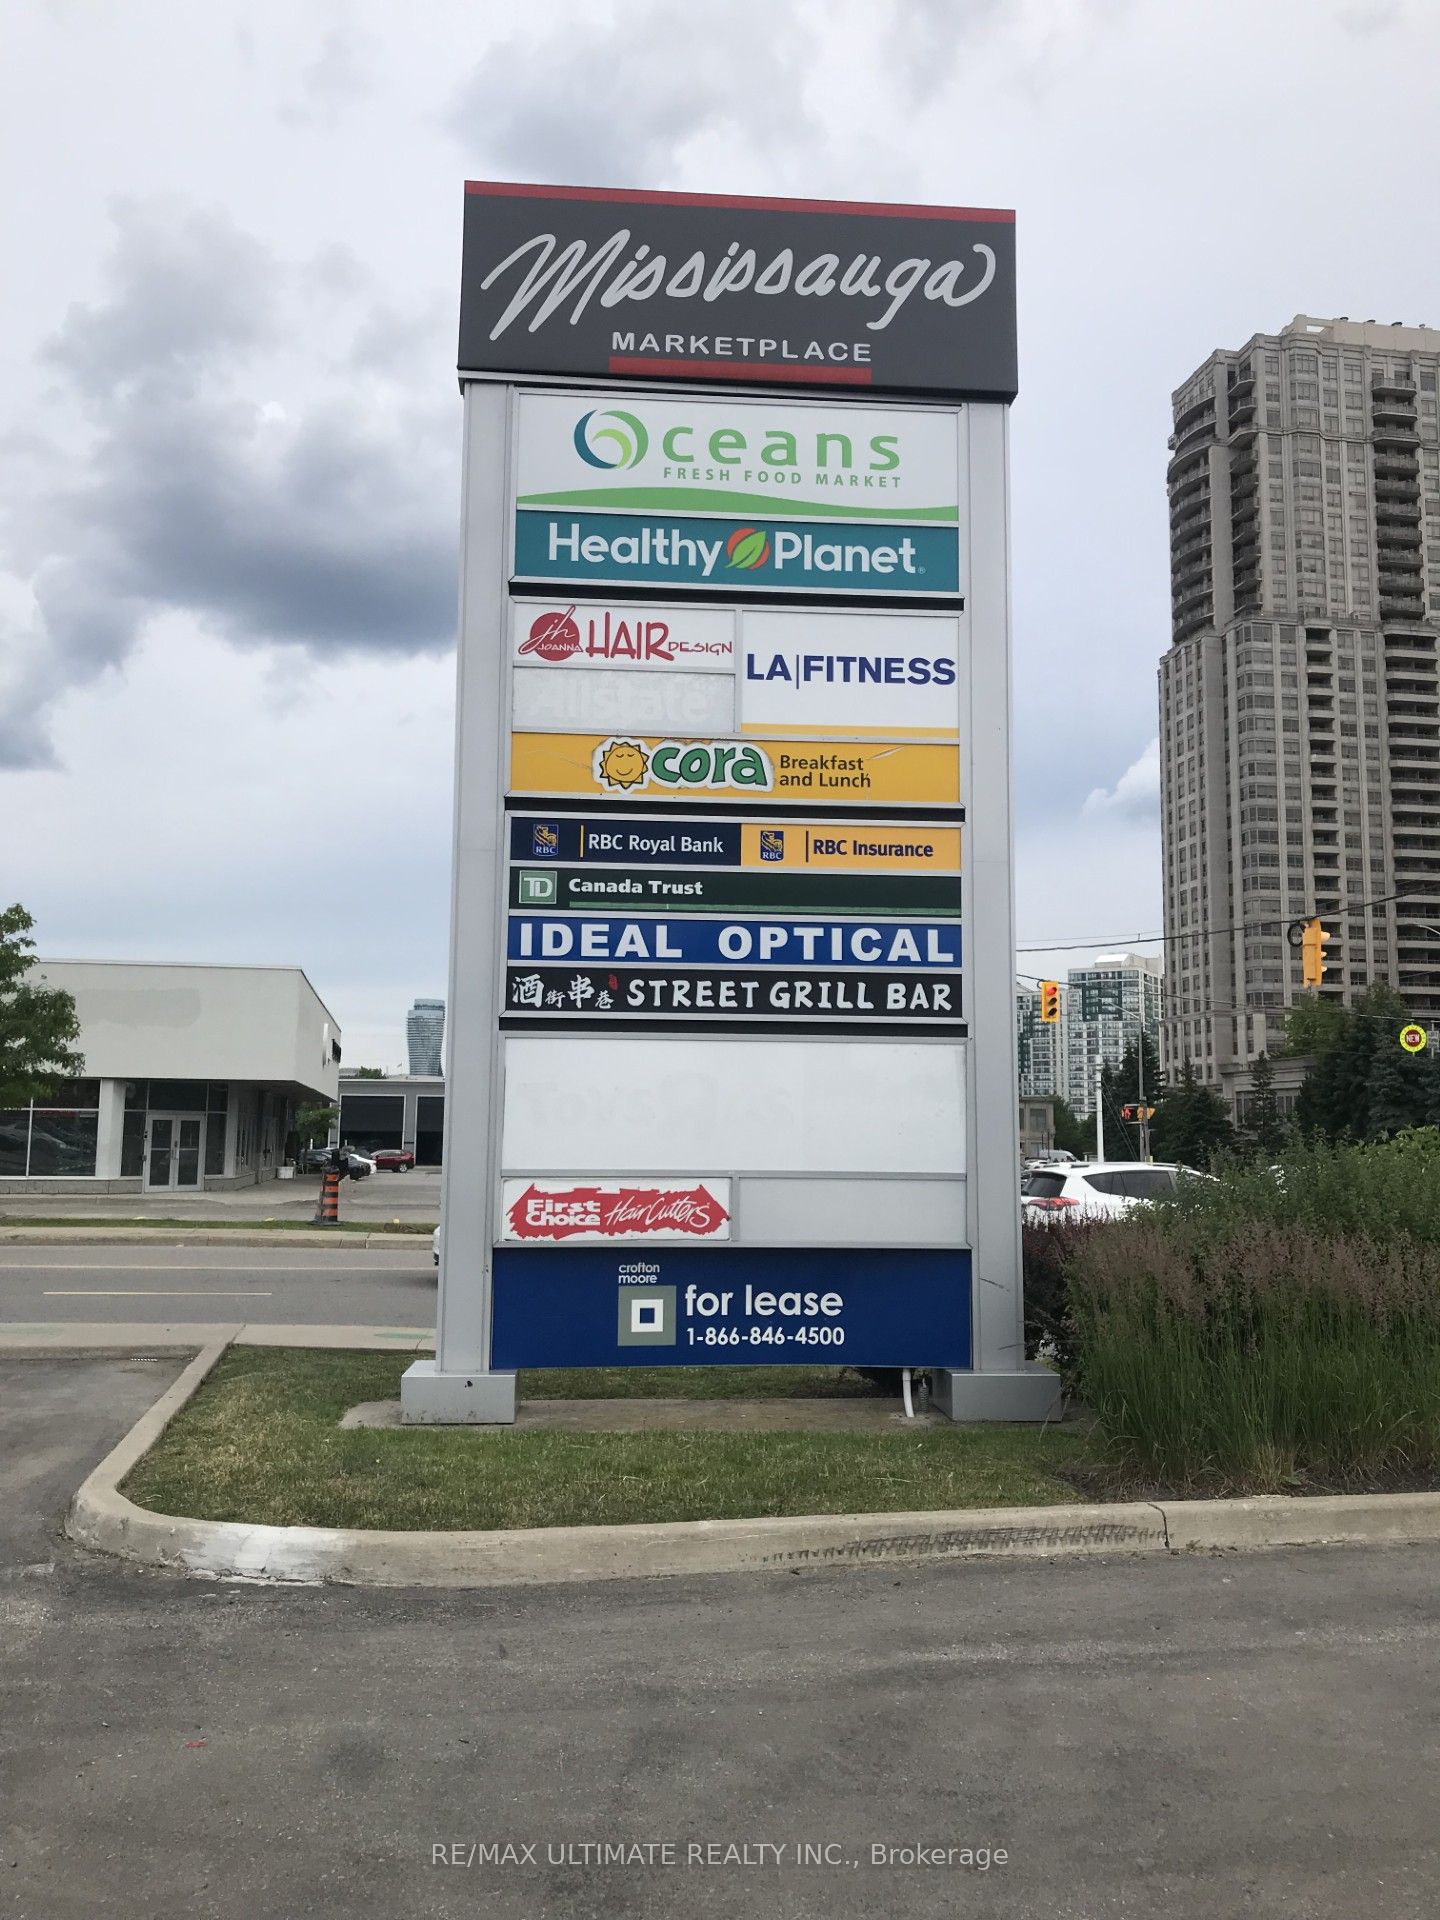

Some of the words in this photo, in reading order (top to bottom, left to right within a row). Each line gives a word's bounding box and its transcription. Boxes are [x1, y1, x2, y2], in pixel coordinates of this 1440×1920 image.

[481, 229, 997, 340] Mississauga
[612, 332, 872, 362] MARKETPLACE
[663, 467, 730, 481] FRESH
[744, 471, 802, 484] FOOD
[816, 474, 901, 488] MARKET
[549, 523, 723, 576] Healthy
[774, 531, 916, 574] Planet
[585, 611, 675, 661] HAIR
[668, 641, 733, 656] DESIGN
[536, 641, 583, 652] JOANNA
[650, 746, 768, 787] cora
[780, 755, 864, 771] Breakfast
[779, 773, 813, 787] and
[819, 773, 871, 788] Lunch
[535, 845, 557, 855] RBC
[588, 833, 623, 850] RBC
[629, 835, 676, 855] Royal
[681, 836, 724, 853] Bank
[813, 839, 848, 855] RBC
[853, 840, 934, 857] Insurance
[762, 851, 782, 860] RBC
[523, 877, 553, 897] TD
[568, 878, 643, 894] Canada
[648, 880, 703, 895] Trust
[520, 922, 683, 958] IDEAL
[718, 925, 954, 963] OPTICAL
[626, 978, 760, 1009] STREET
[769, 981, 874, 1009] GRILL
[886, 983, 952, 1011] BAR
[527, 1199, 600, 1213] First
[525, 1211, 600, 1226] Choice
[618, 1262, 660, 1274] crofton
[618, 1274, 658, 1284] moore
[685, 1284, 734, 1316] for
[745, 1284, 843, 1316] lease
[687, 1326, 845, 1346] 1-866-846-4500
